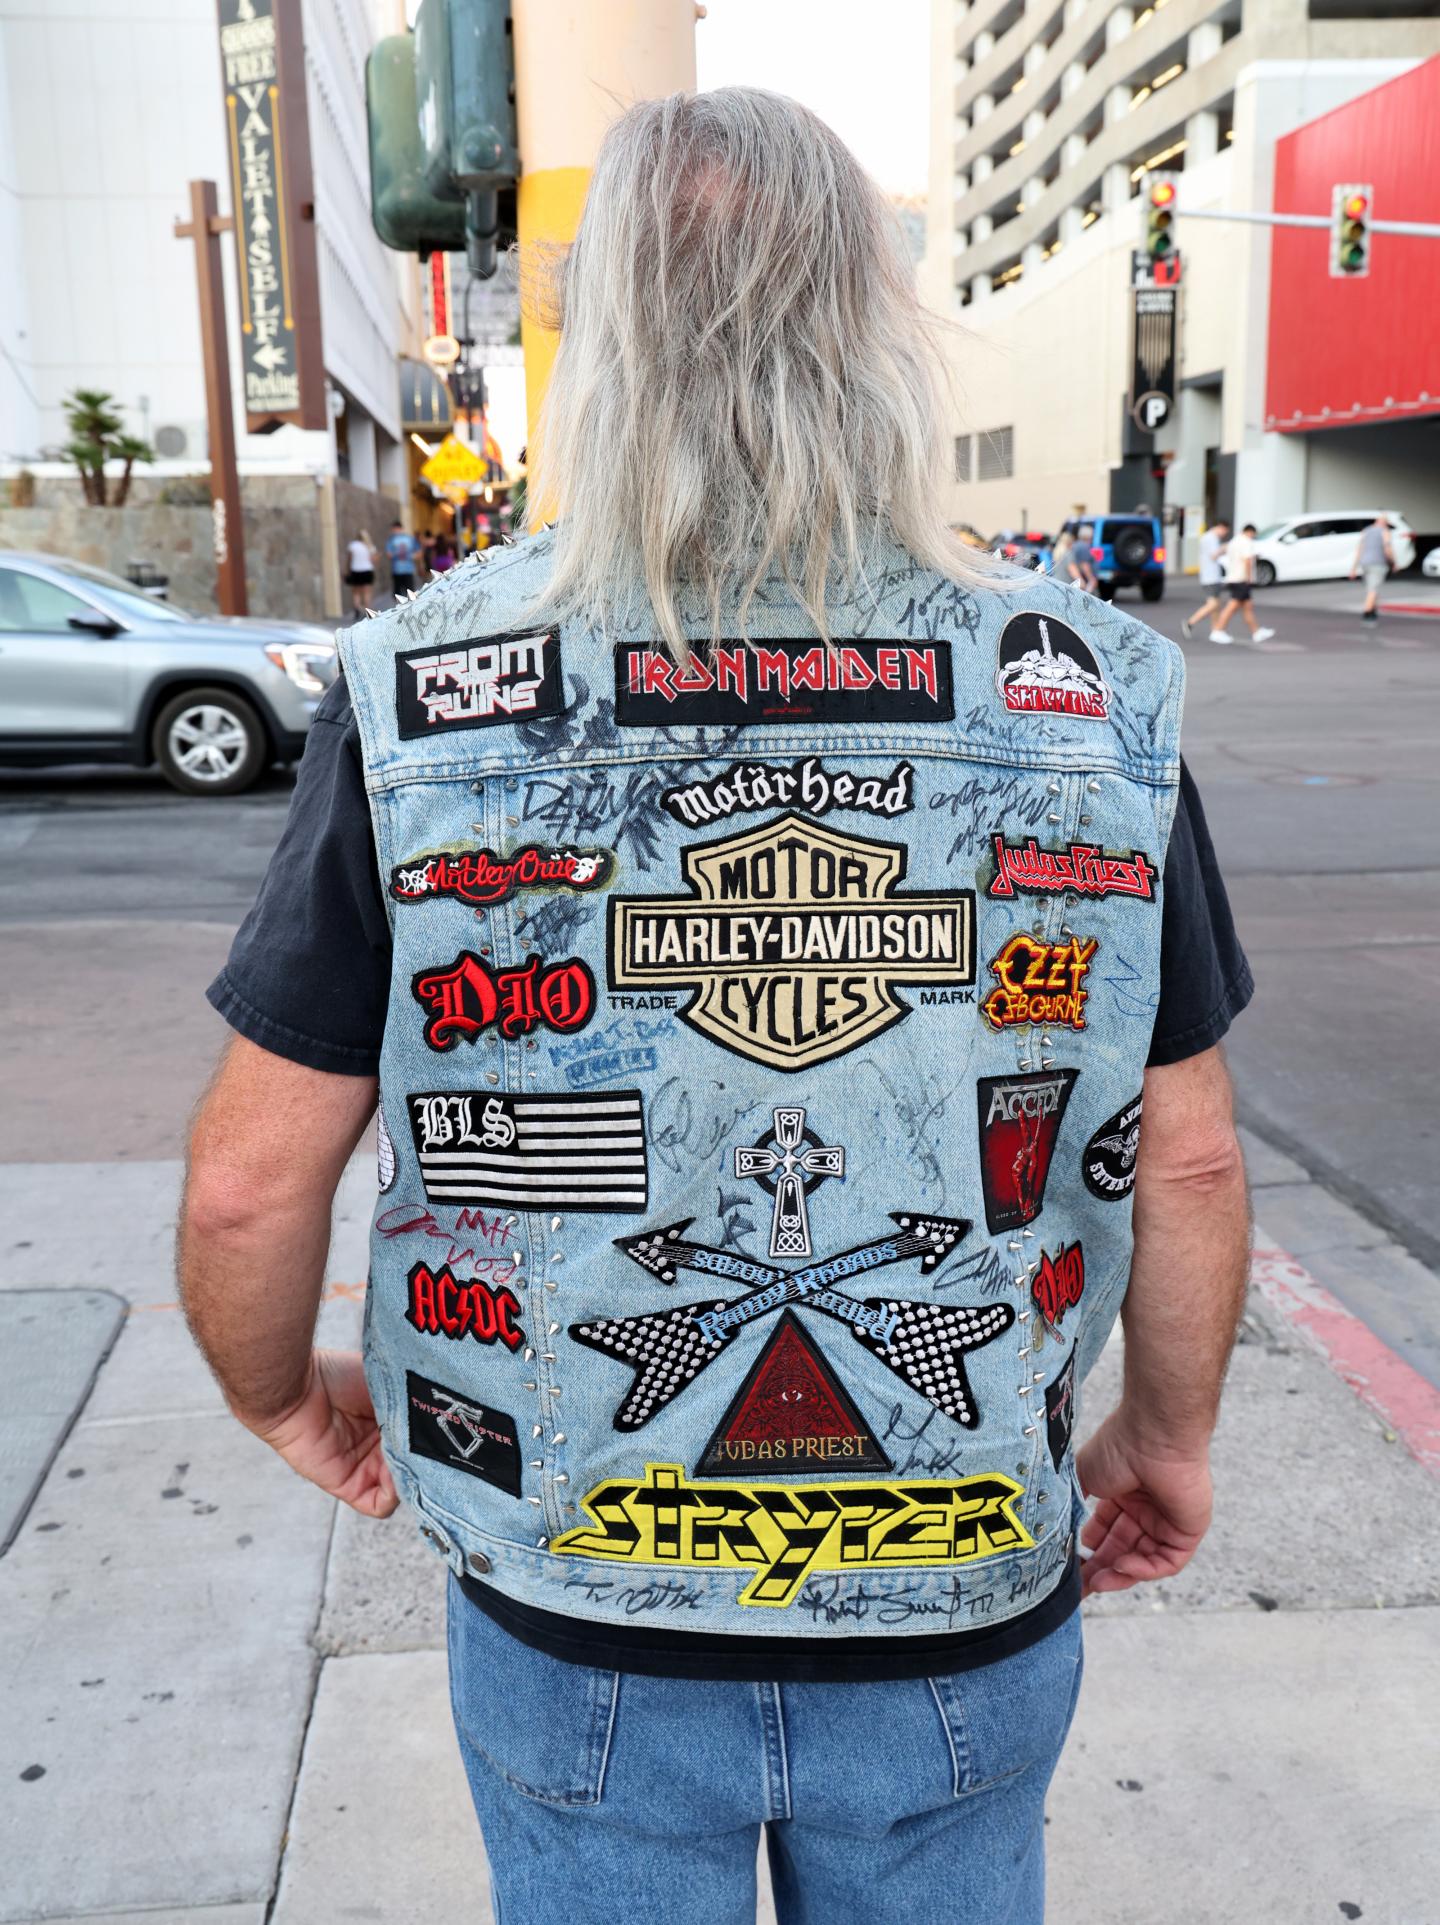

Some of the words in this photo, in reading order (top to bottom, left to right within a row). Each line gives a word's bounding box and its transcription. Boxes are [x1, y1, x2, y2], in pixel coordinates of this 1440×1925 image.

[1147, 398, 1166, 427] P
[405, 635, 552, 701] FROM
[628, 648, 748, 704] IRON
[751, 647, 938, 703] MAIDEN
[420, 679, 543, 724] RUINS
[720, 838, 868, 899] MOTOR
[991, 837, 1073, 897] Judas
[1071, 846, 1154, 897] Priest
[635, 914, 956, 963] HARLEY-DAVIDSON
[418, 955, 591, 1048] DIO
[608, 995, 677, 1010] TRADE
[722, 976, 867, 1046] CYCLES
[920, 990, 975, 1005] MARK
[414, 1096, 516, 1152] BLS
[716, 1439, 786, 1461] JUDAS
[792, 1435, 869, 1461] PRIEST
